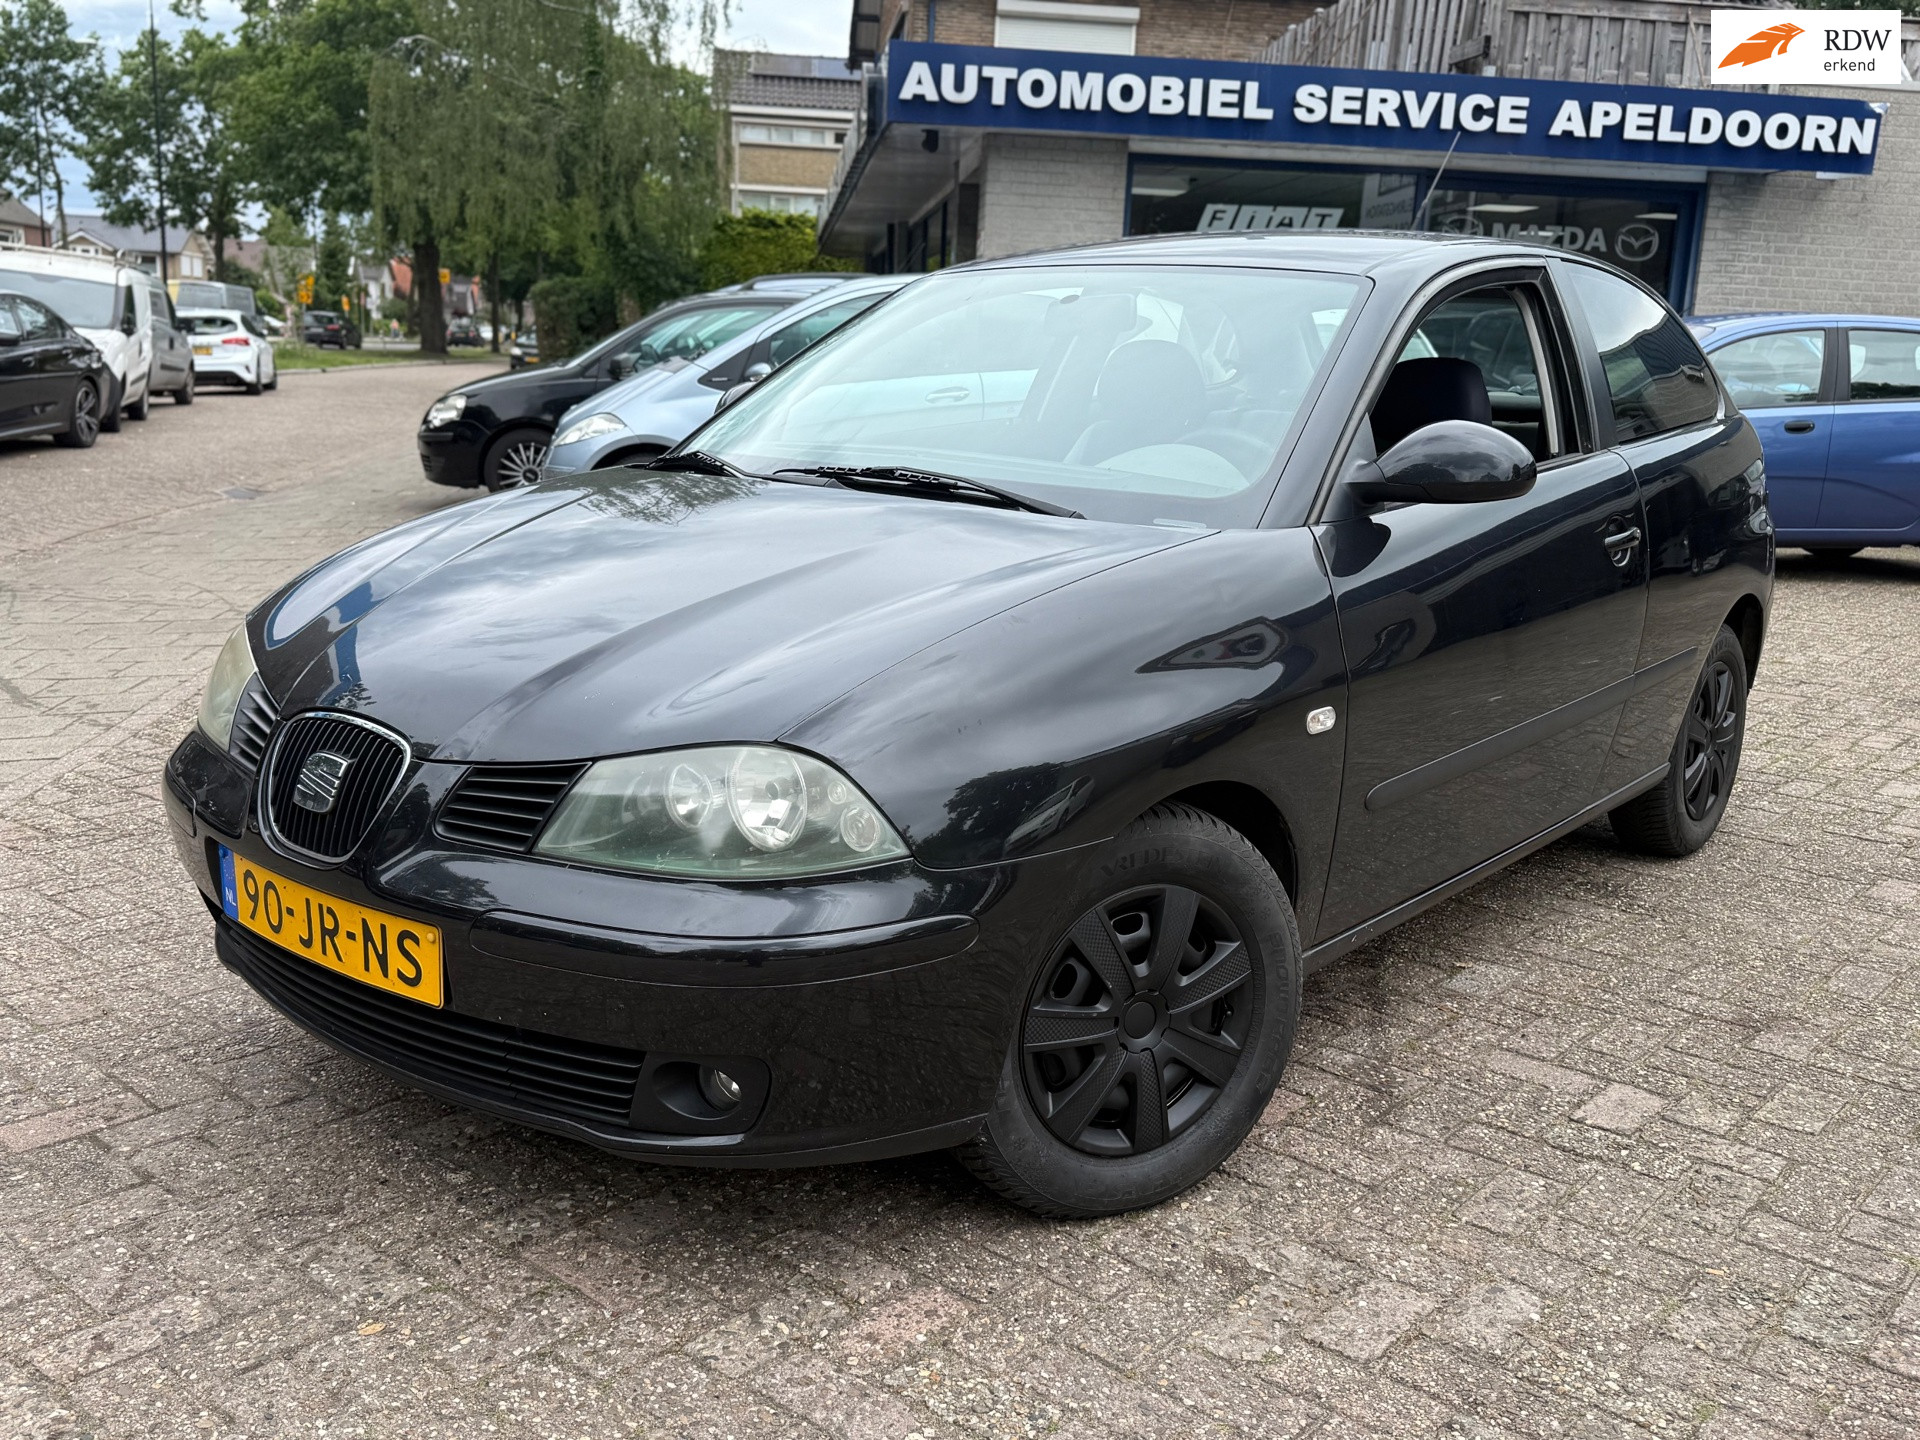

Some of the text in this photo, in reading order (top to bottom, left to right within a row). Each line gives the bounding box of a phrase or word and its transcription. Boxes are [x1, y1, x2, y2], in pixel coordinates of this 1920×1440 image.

[899, 61, 1877, 155] AUTOMOBIEL SERVICE APELDOORN
[1491, 222, 1608, 252] MAZDA
[225, 893, 237, 906] NL
[243, 869, 422, 987] 90-JR-NS
